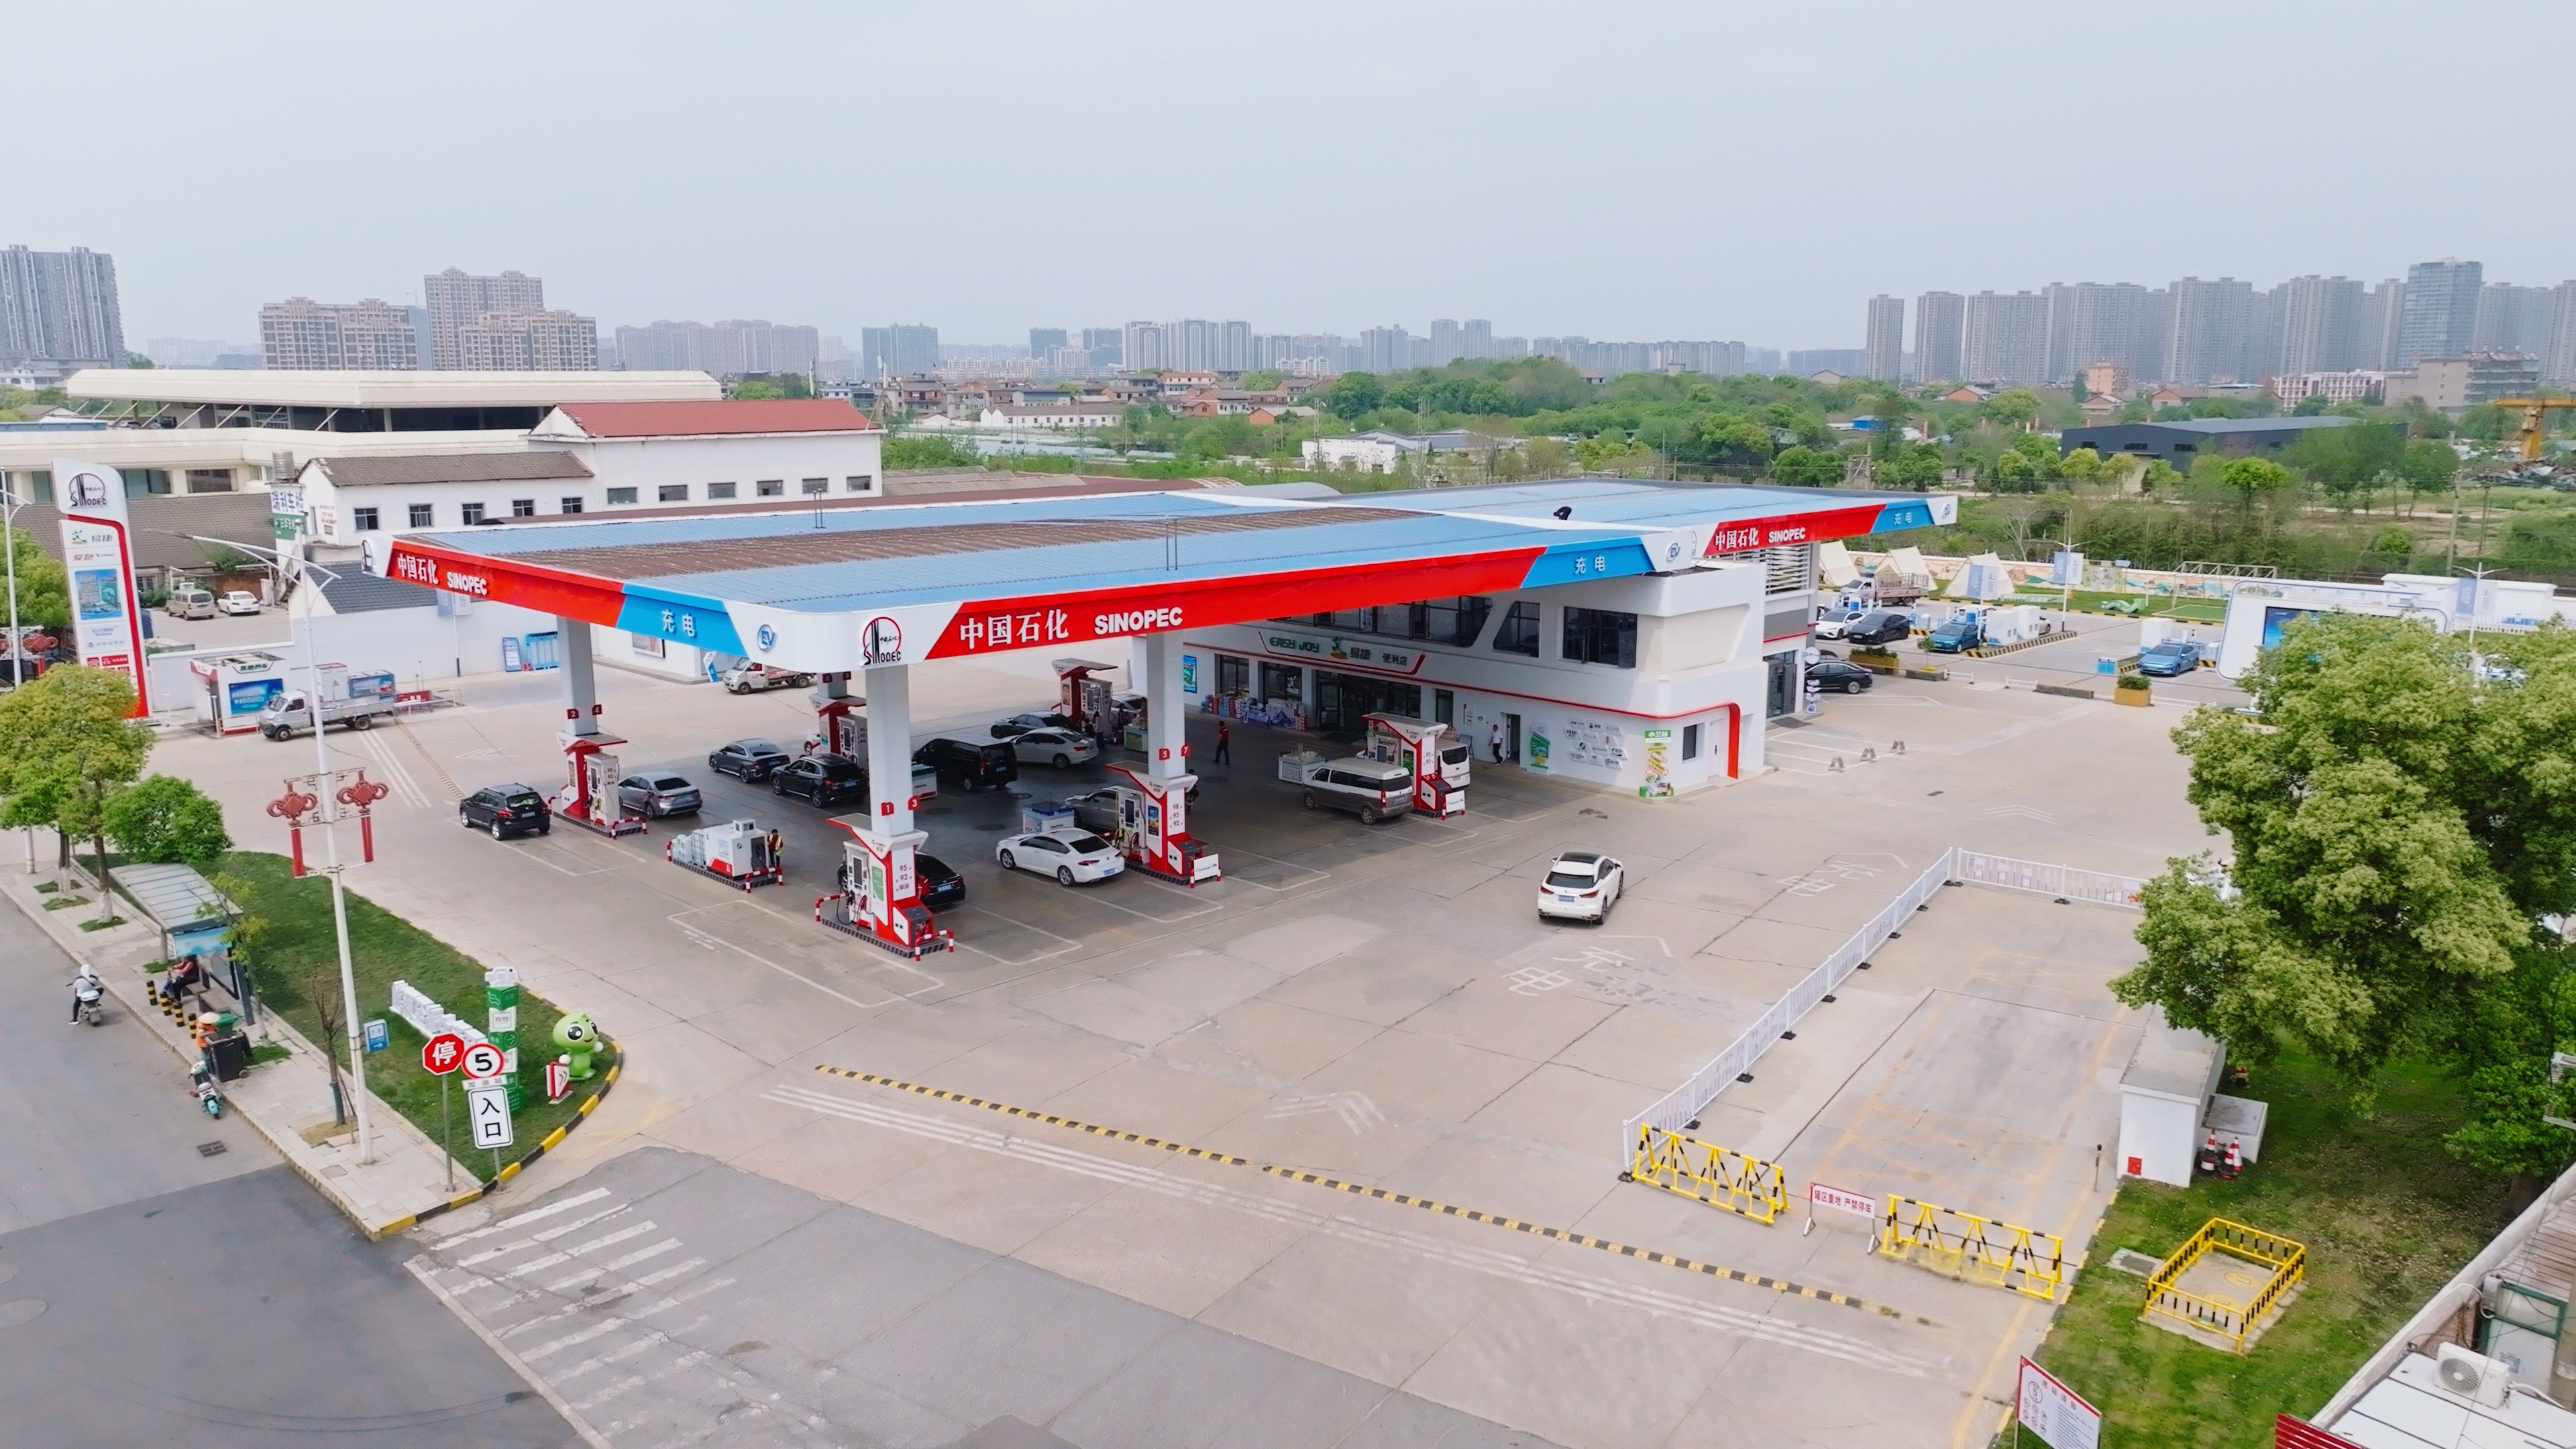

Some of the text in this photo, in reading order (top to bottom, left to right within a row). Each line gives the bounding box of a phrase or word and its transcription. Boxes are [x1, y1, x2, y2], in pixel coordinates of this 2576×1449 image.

[1893, 511, 1912, 525] 充电
[1715, 527, 1805, 551] 中国石化 SINOPEC
[397, 546, 487, 596] 中国石化 SINOPEC
[1574, 554, 1605, 574] 充电
[661, 608, 697, 638] 充电
[960, 607, 1183, 649] 中国石化 SINOPEC
[1269, 637, 1320, 653] EASY JOY
[1349, 647, 1371, 661] 易捷
[1383, 653, 1407, 665] 便利店
[431, 1040, 457, 1067] 停
[475, 1053, 492, 1071] 5
[468, 1078, 502, 1087] 加油站
[481, 1097, 501, 1138] 入口
[1844, 1197, 1872, 1213] 严禁停车
